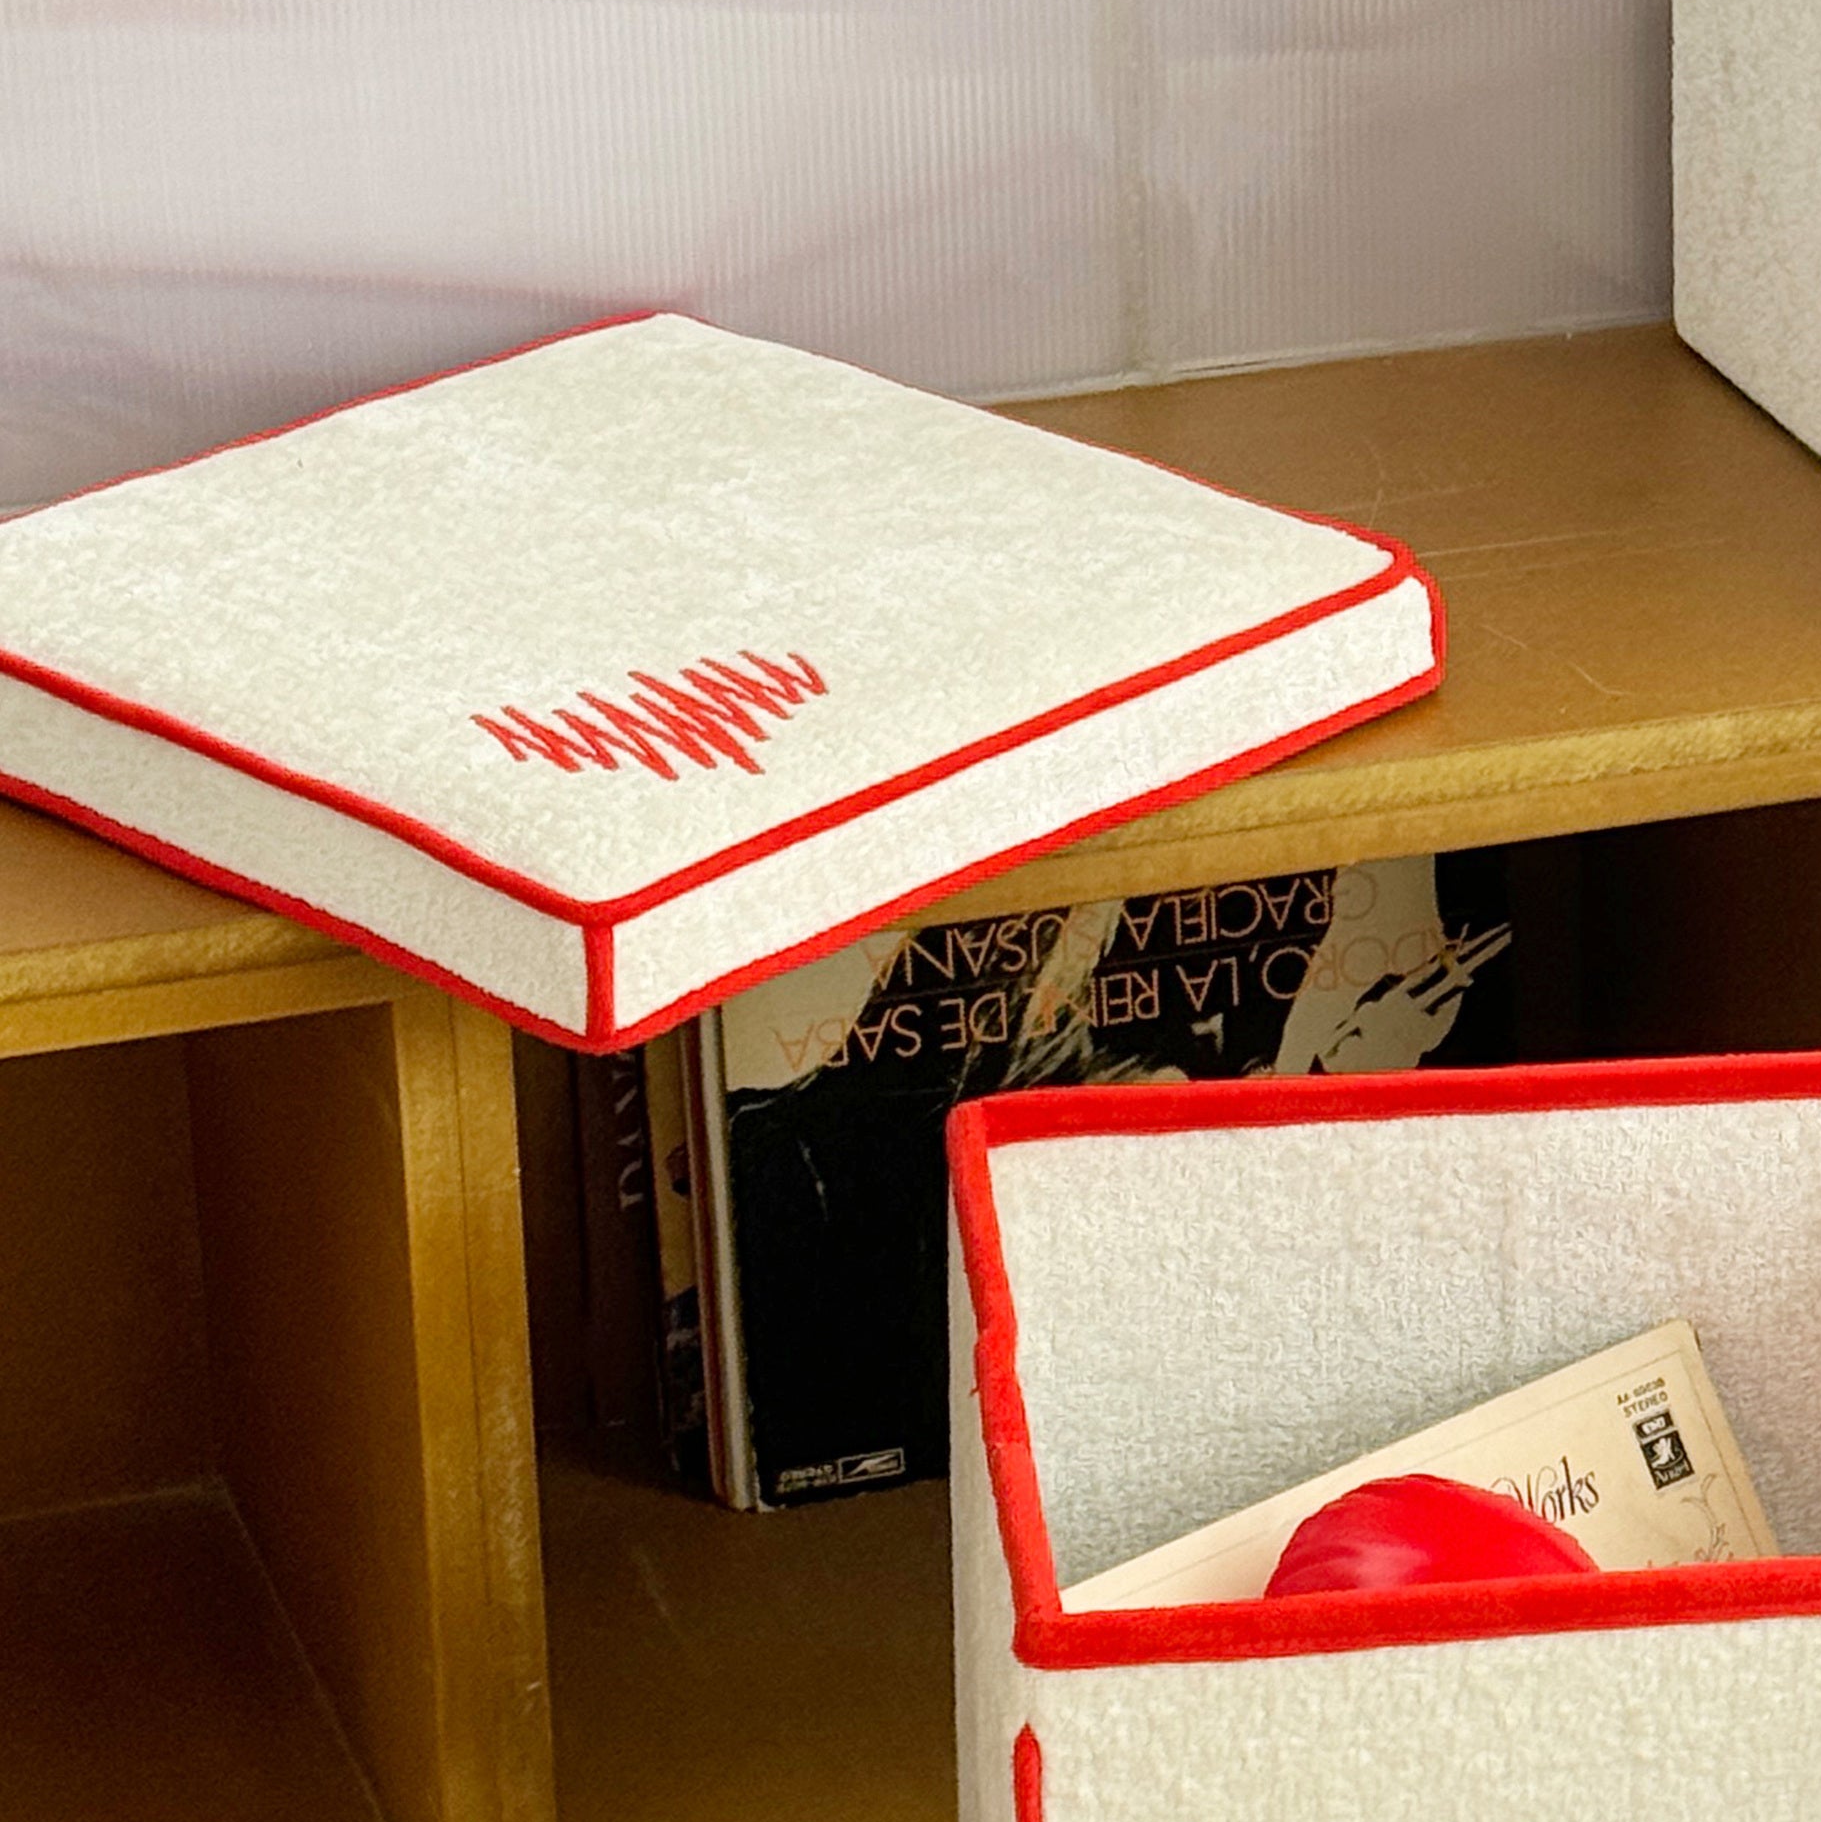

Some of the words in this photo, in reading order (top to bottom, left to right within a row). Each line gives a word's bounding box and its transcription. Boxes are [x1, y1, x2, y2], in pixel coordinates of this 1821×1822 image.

[1120, 864, 1377, 952] GRACIELA
[1175, 956, 1240, 1014] LA
[772, 1004, 922, 1072] SABA
[939, 990, 1008, 1051] DE
